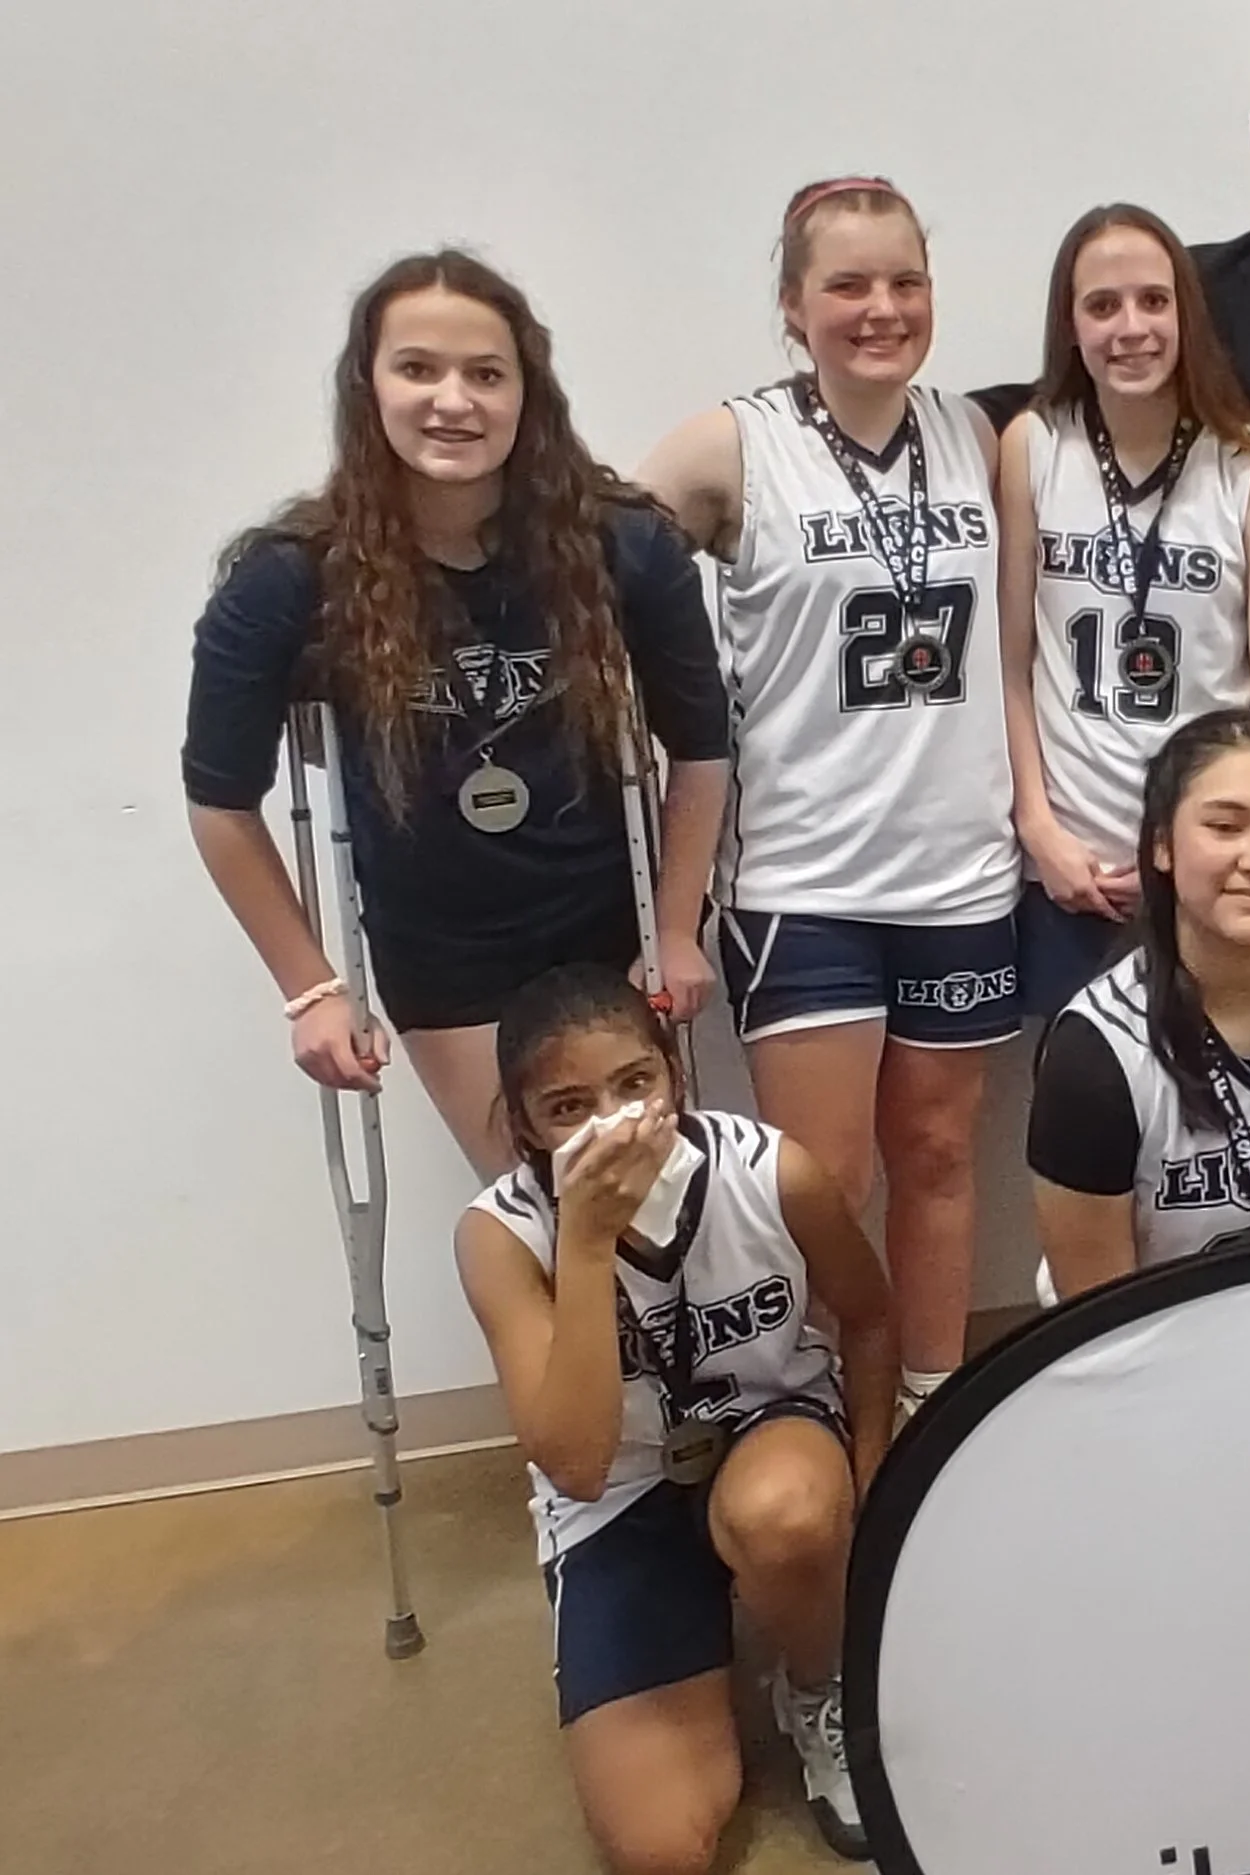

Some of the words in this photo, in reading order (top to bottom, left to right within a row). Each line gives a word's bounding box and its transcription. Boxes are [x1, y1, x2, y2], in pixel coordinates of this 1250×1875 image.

[867, 500, 909, 592] FIRST
[911, 491, 927, 582] PLACE
[1111, 505, 1137, 594] PLACE
[839, 577, 977, 713] 27
[898, 965, 1016, 1012] LIONS
